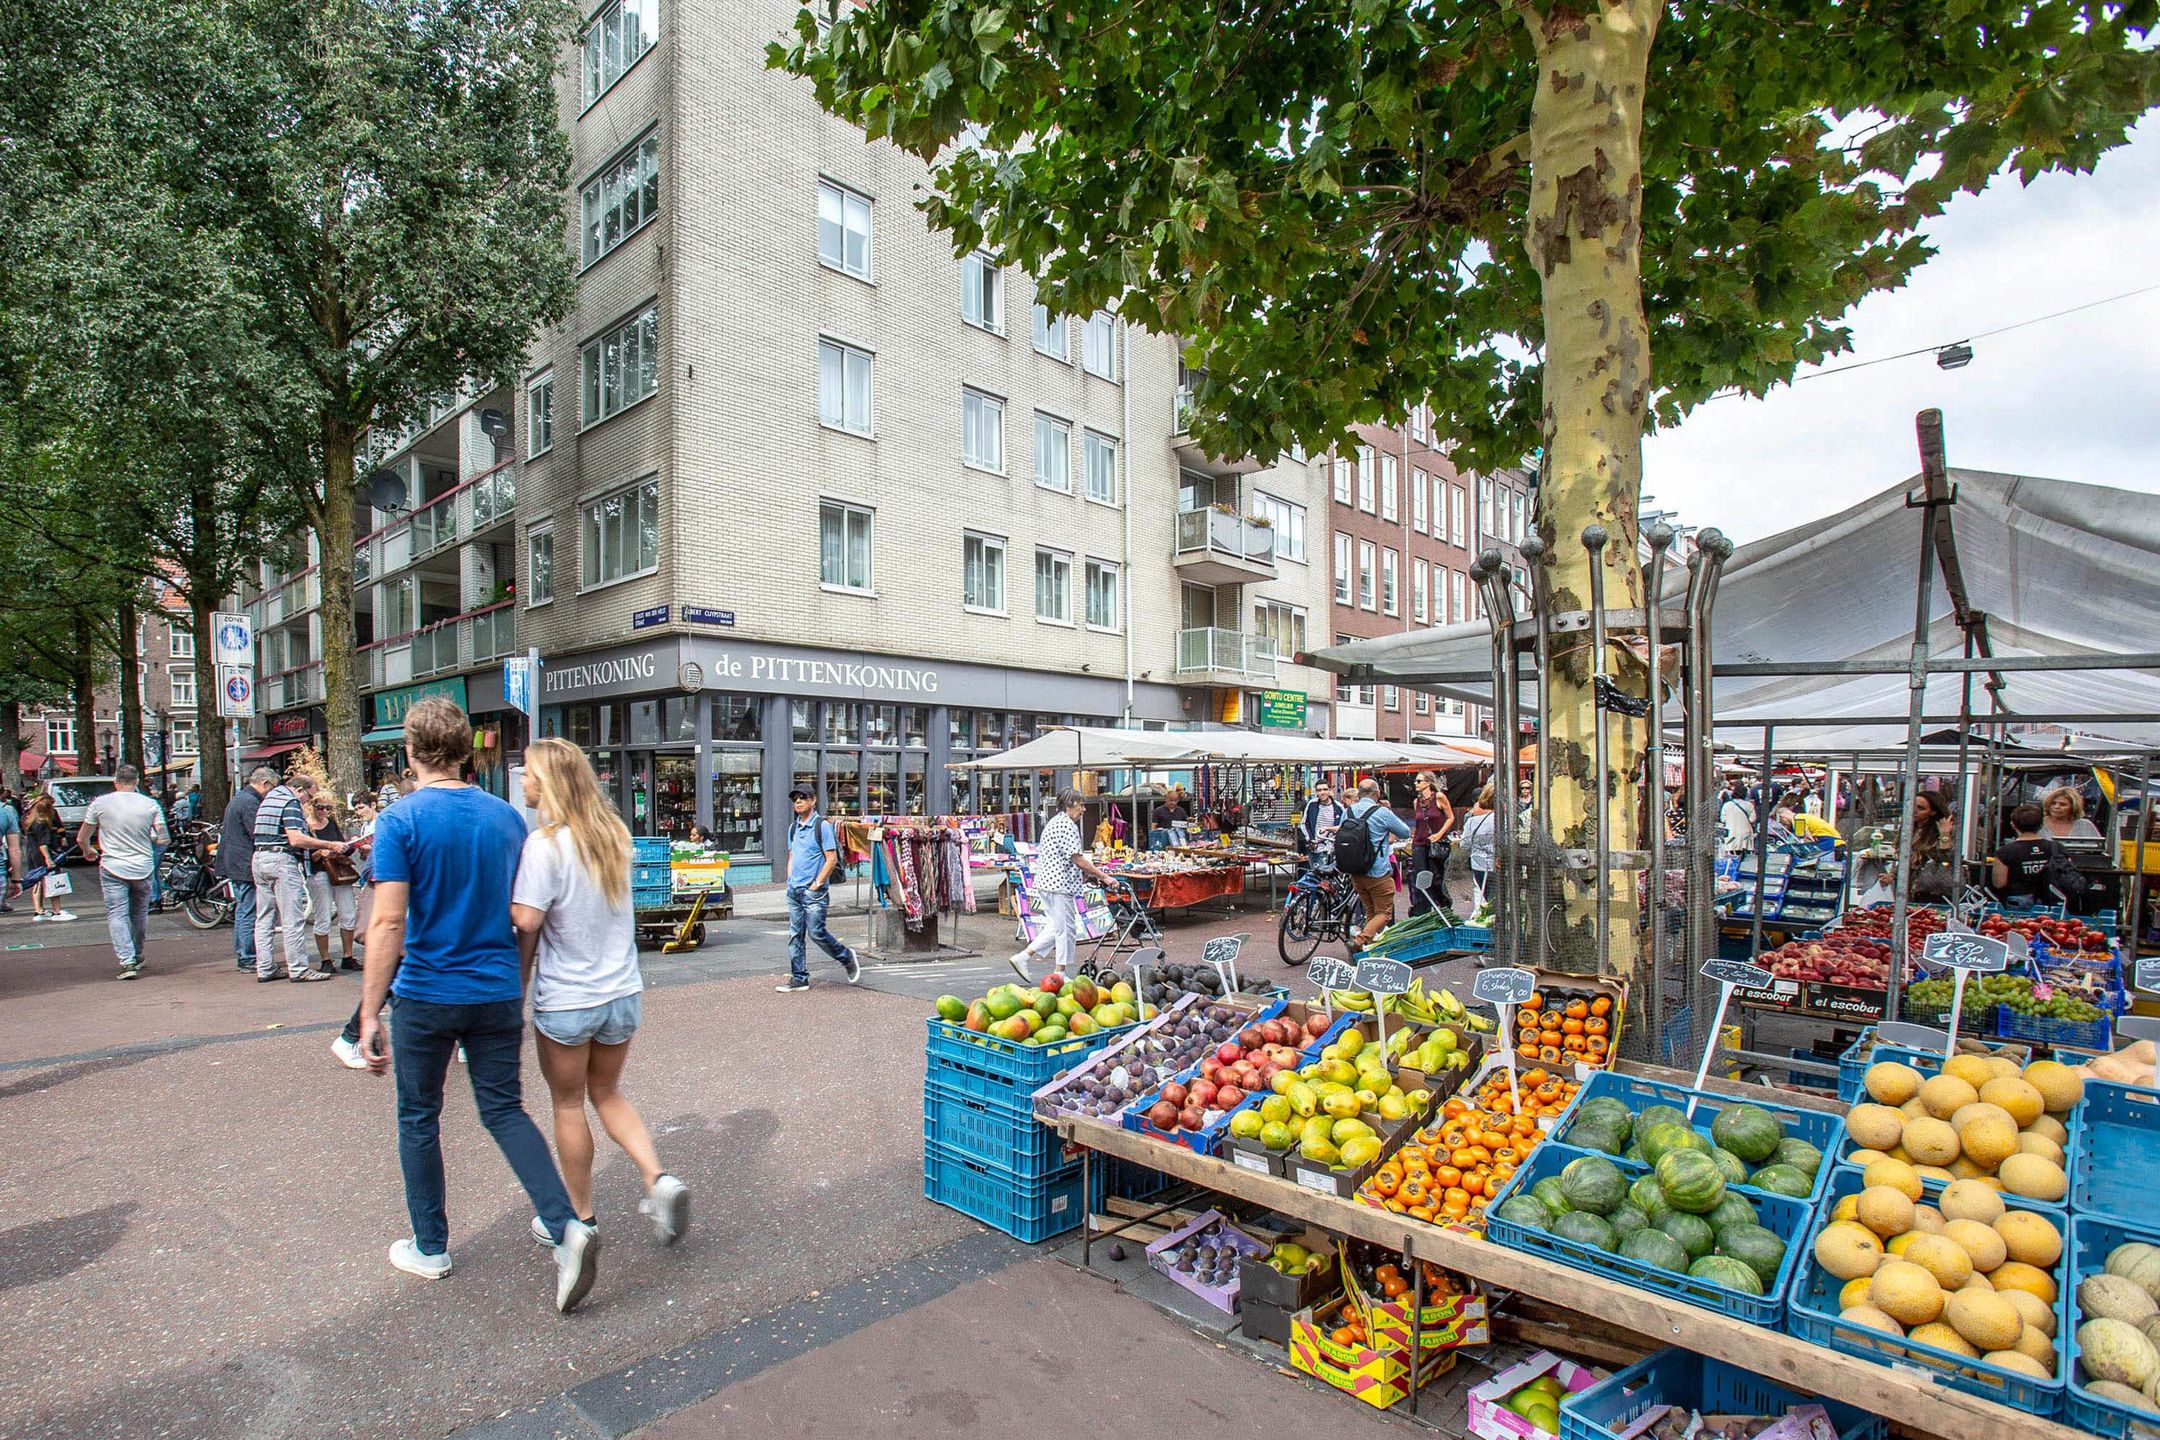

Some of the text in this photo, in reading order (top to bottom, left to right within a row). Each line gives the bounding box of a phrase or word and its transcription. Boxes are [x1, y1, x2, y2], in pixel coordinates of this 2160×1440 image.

[545, 653, 655, 692] PITTENKONING
[714, 653, 742, 677] de
[750, 656, 938, 692] PITTENKONING
[1283, 694, 1304, 703] CENTRE
[1361, 961, 1397, 975] papaya
[1733, 988, 1793, 1003] el escobar
[1815, 997, 1882, 1014] el escobar
[1406, 1306, 1453, 1321] SARON
[1318, 1340, 1358, 1362] SHARON
[1316, 1363, 1355, 1388] SHARON
